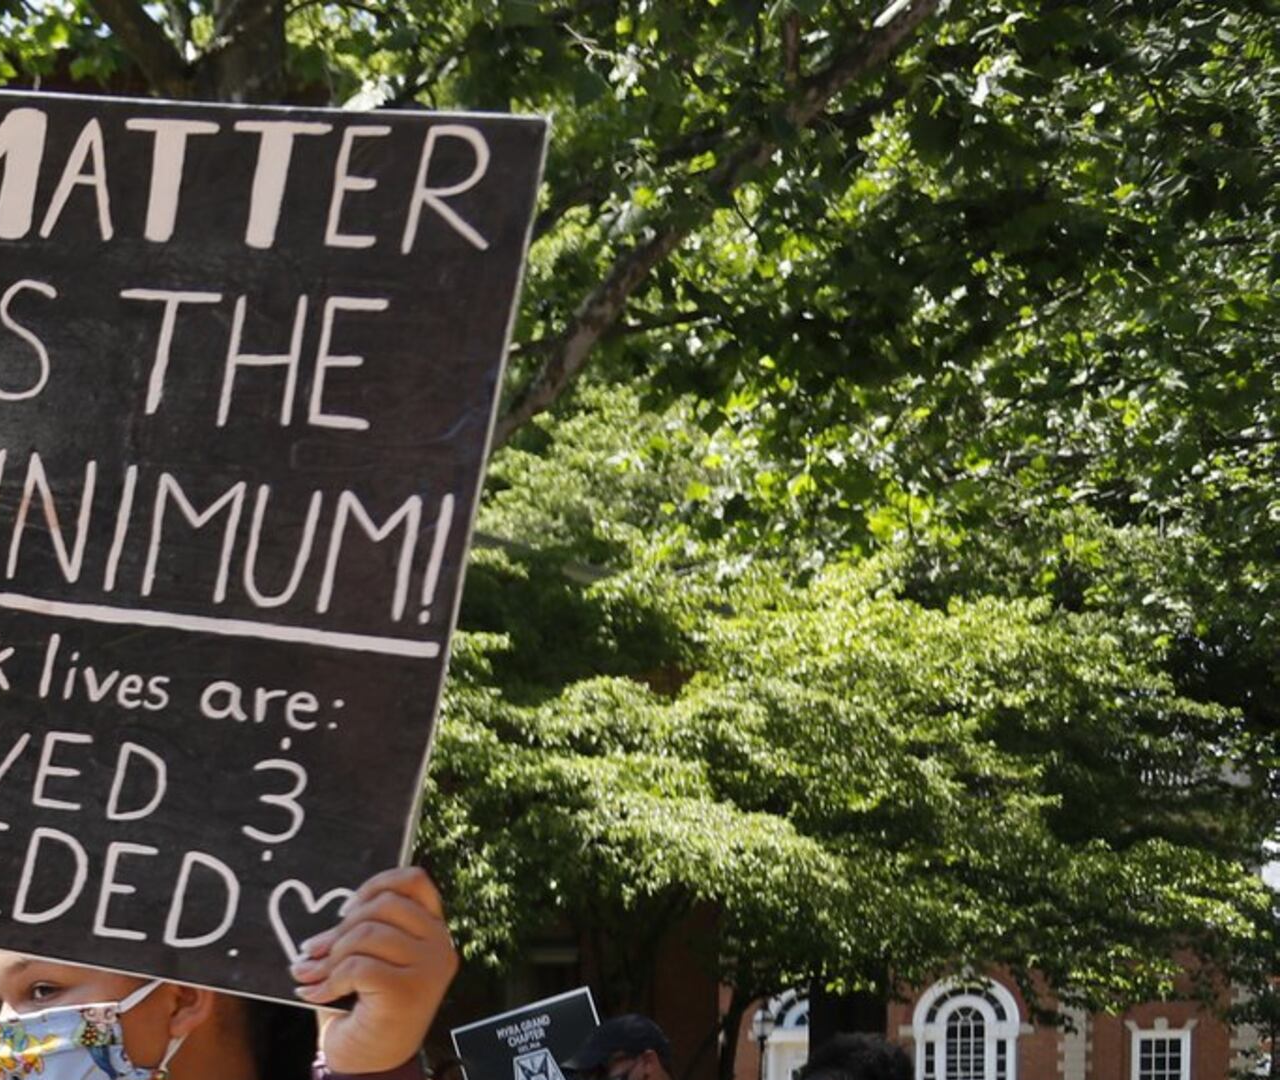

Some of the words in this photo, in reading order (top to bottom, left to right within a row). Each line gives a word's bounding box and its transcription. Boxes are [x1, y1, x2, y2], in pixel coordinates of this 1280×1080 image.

[120, 288, 389, 429] THE
[39, 634, 171, 711] lives
[199, 679, 346, 731] are:
